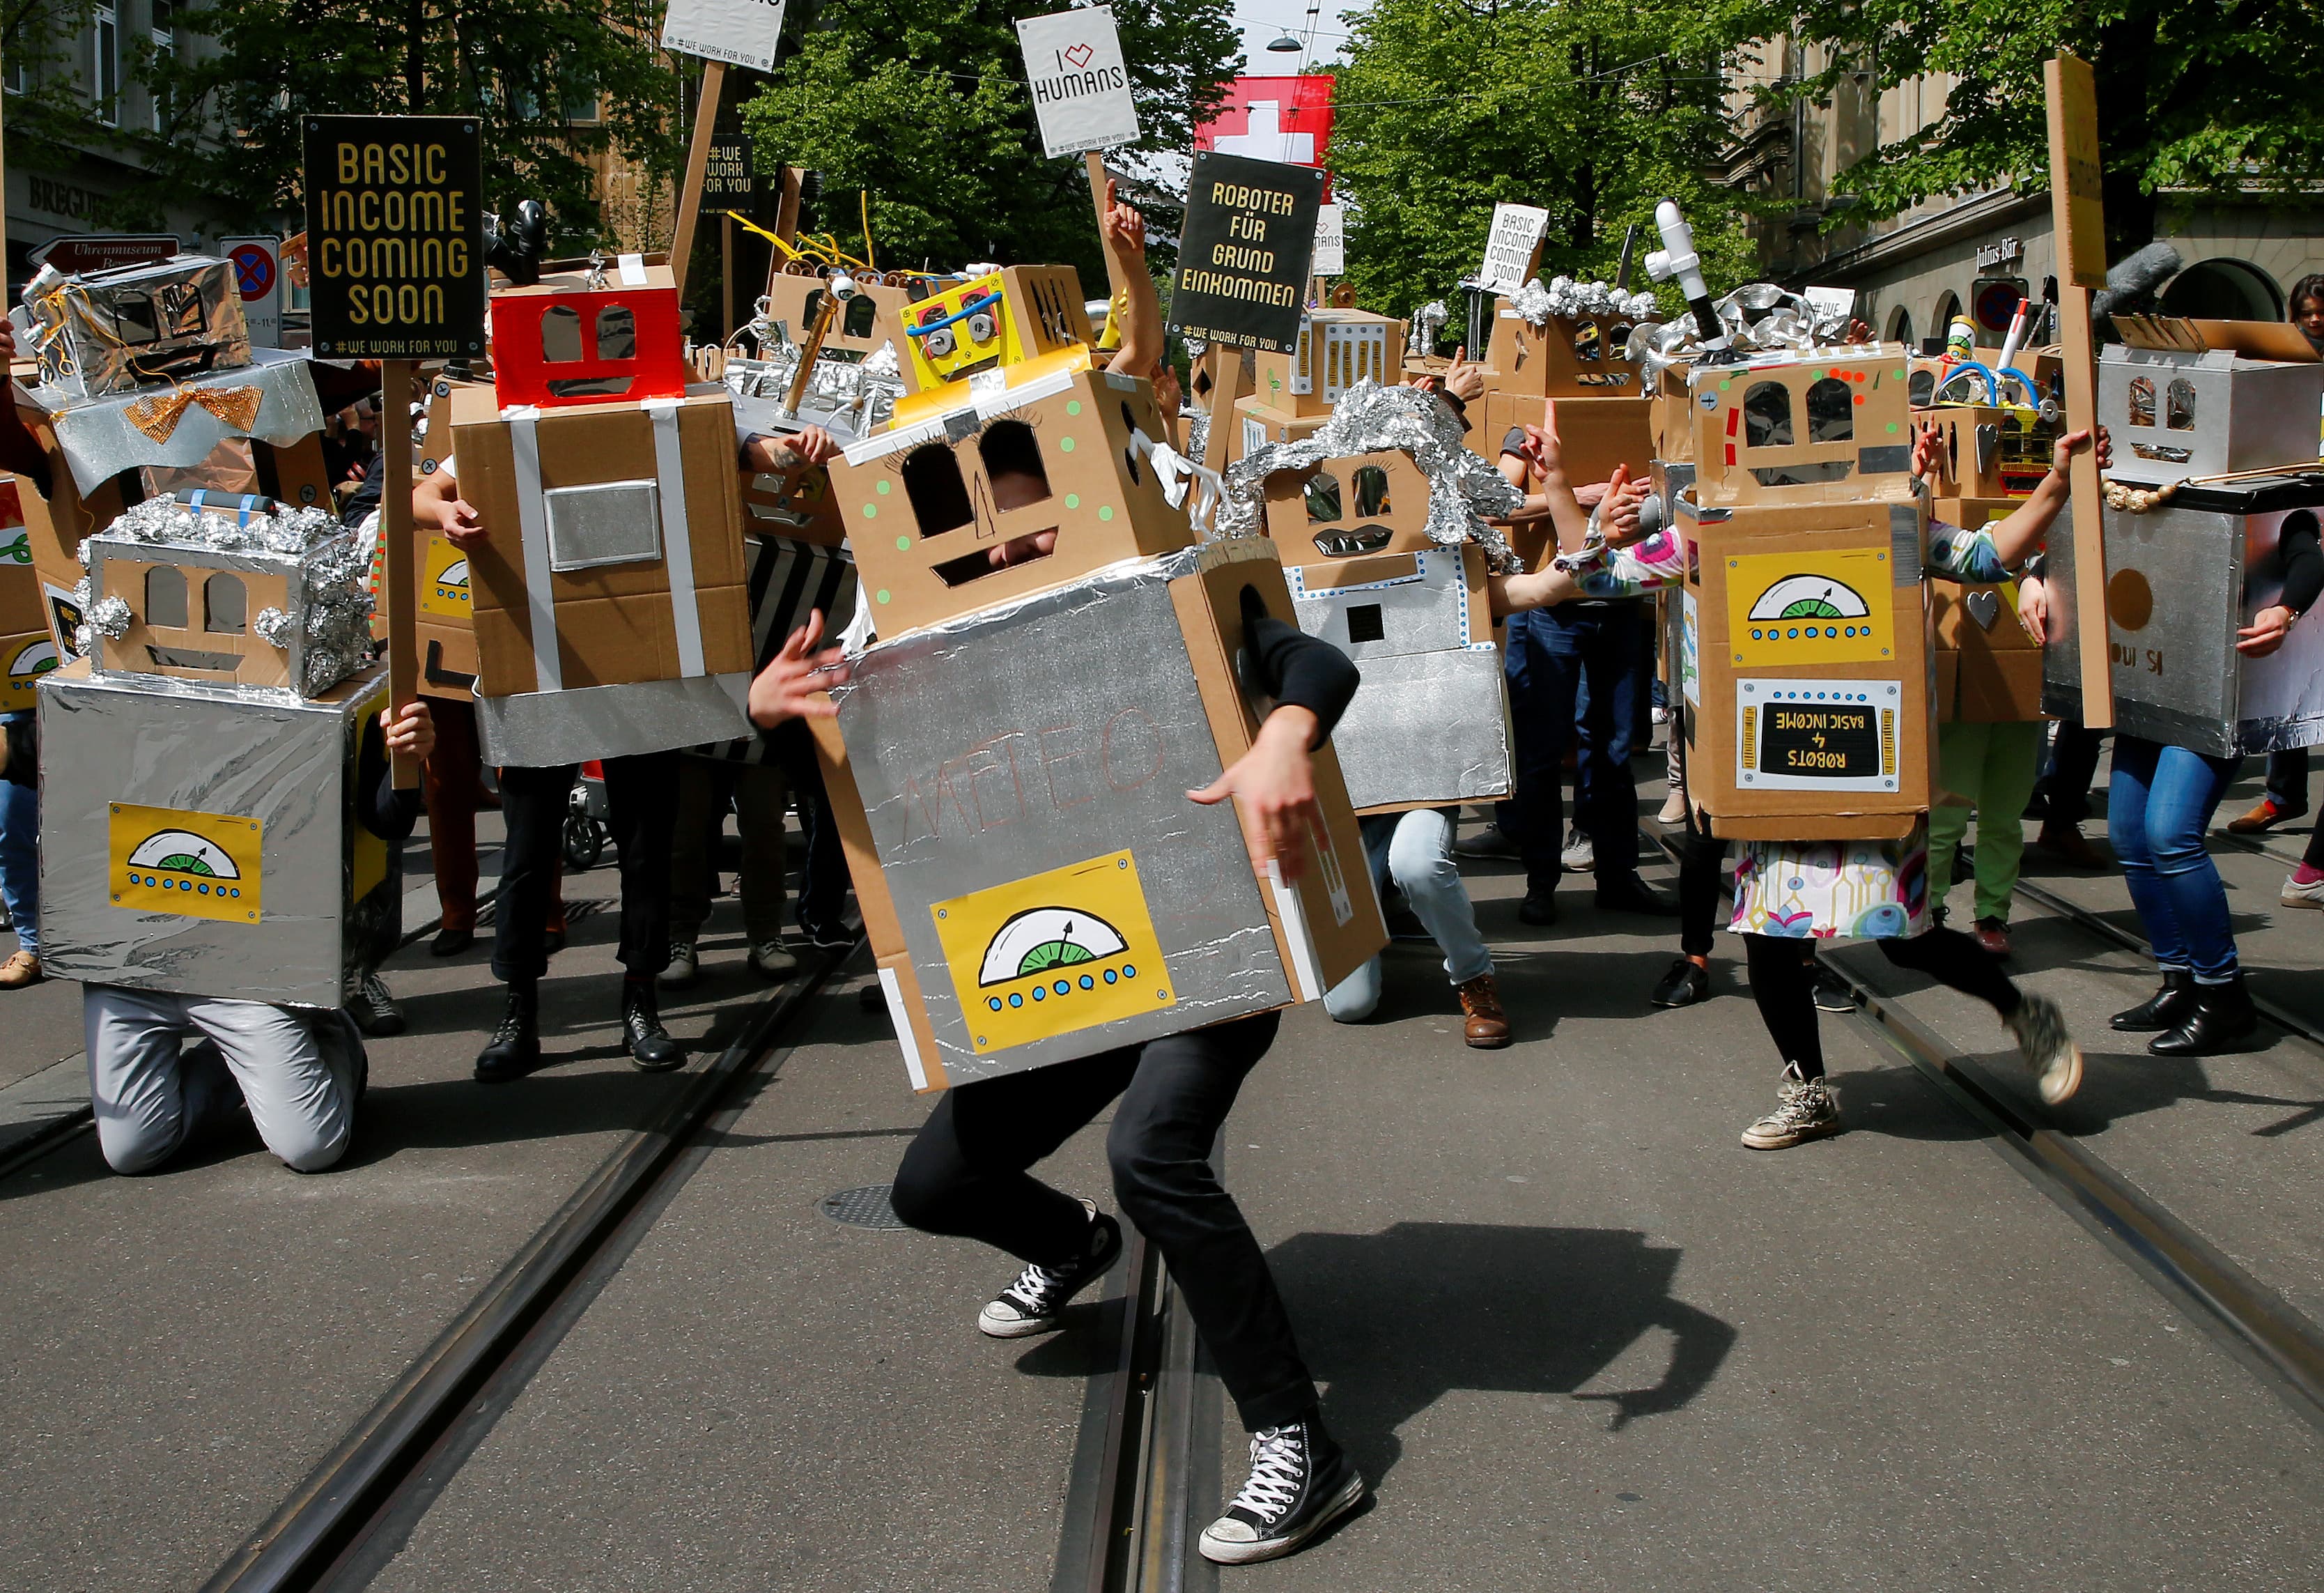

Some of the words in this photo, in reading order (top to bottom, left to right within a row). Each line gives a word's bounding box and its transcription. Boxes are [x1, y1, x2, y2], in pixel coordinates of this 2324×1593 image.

[676, 38, 697, 51] #WE
[699, 43, 721, 56] WORK
[724, 49, 737, 61] FOR
[741, 52, 755, 64] YOU
[1055, 49, 1063, 72] I
[1035, 66, 1124, 104] HUMANS
[1098, 135, 1111, 145] FOR
[1112, 132, 1125, 142] YOU
[338, 143, 446, 184] BASIC
[708, 146, 741, 161] #WE
[707, 162, 743, 177] WORK
[704, 178, 722, 192] OR
[727, 178, 751, 193] YOU
[1211, 181, 1294, 217] ROBOTER
[321, 190, 465, 231] INCOME
[1228, 210, 1266, 243] FÜR
[1502, 213, 1535, 233] BASIC
[75, 244, 162, 256] Uhrenmuseum
[1494, 229, 1536, 251] INCOME
[321, 238, 468, 278] COMING
[1211, 243, 1274, 274] GRUND
[1976, 245, 2001, 274] Julius
[2001, 237, 2017, 261] Bär
[1493, 263, 1522, 283] SOON
[1181, 268, 1295, 308] EINKOMMEN
[348, 284, 444, 324] SOON
[1812, 301, 1841, 318] #WE
[335, 340, 366, 353] #WE
[370, 340, 405, 353] WORK
[410, 340, 431, 353] FOR
[435, 339, 458, 353] YOU
[1183, 325, 1208, 340] #WE
[1209, 329, 1237, 344] WORK
[1239, 334, 1256, 347] FOR
[1259, 337, 1278, 351] YOU
[1776, 712, 1827, 730] INCOME
[1830, 714, 1865, 729] BASIC
[1811, 732, 1826, 749] 4
[1788, 749, 1847, 769] ROBOTS
